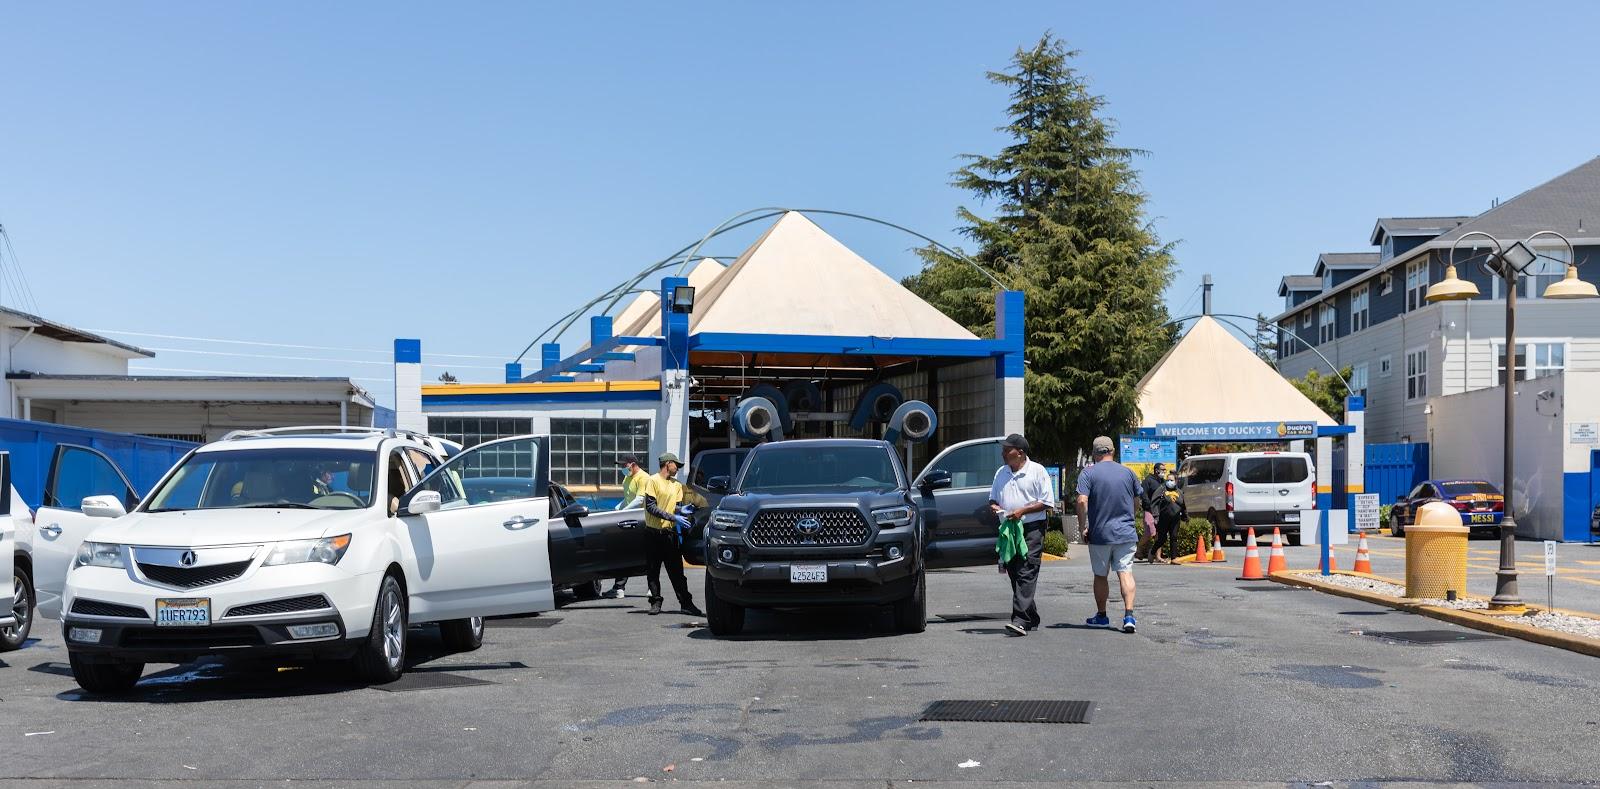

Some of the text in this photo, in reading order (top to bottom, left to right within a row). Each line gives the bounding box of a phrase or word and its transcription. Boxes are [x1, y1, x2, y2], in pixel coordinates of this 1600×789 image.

[1161, 425, 1272, 436] WELCOME TO DUCKY'S
[1471, 514, 1494, 523] MESSI
[793, 571, 825, 580] 42524F3
[160, 609, 206, 621] 1UFR793
